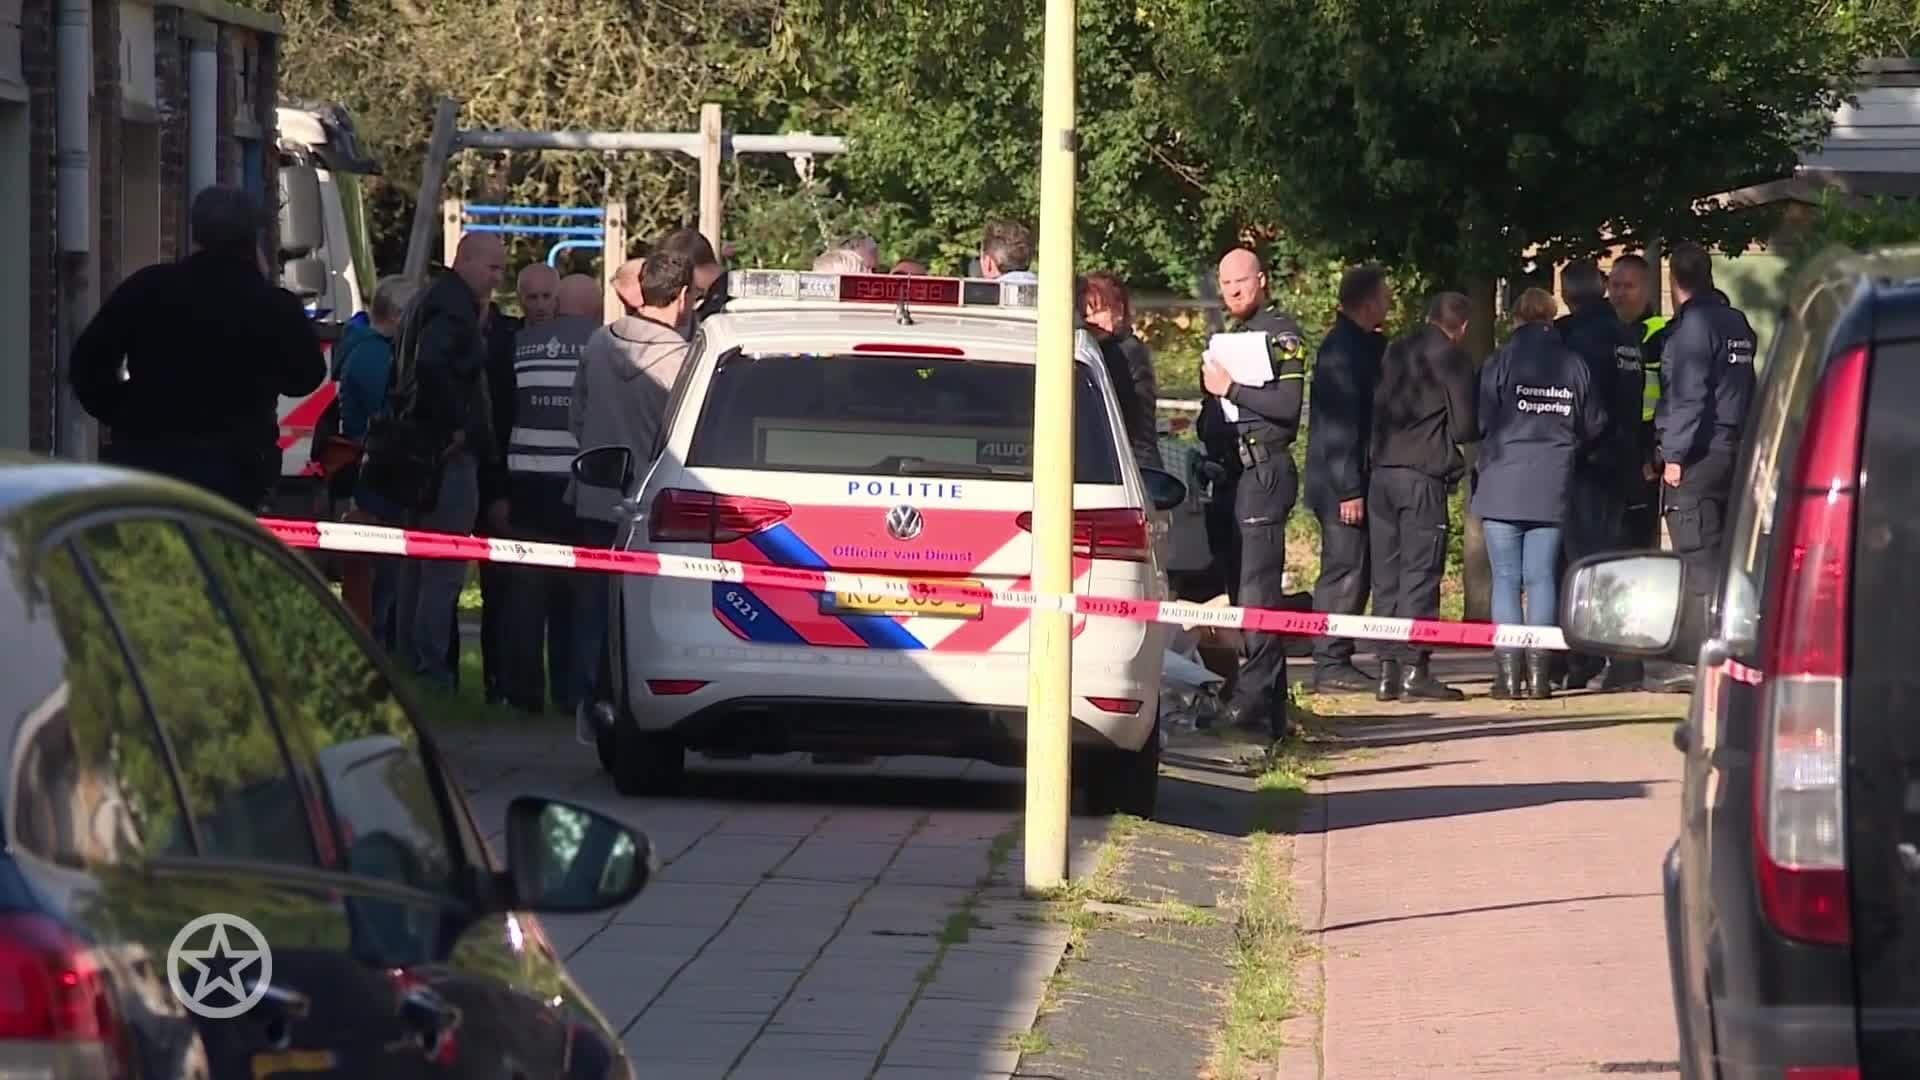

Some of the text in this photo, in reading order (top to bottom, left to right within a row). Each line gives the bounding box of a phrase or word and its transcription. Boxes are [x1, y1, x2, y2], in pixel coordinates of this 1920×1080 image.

[848, 481, 962, 499] POLITIE
[832, 545, 972, 562] Officier van Dienst
[726, 591, 759, 622] 6221
